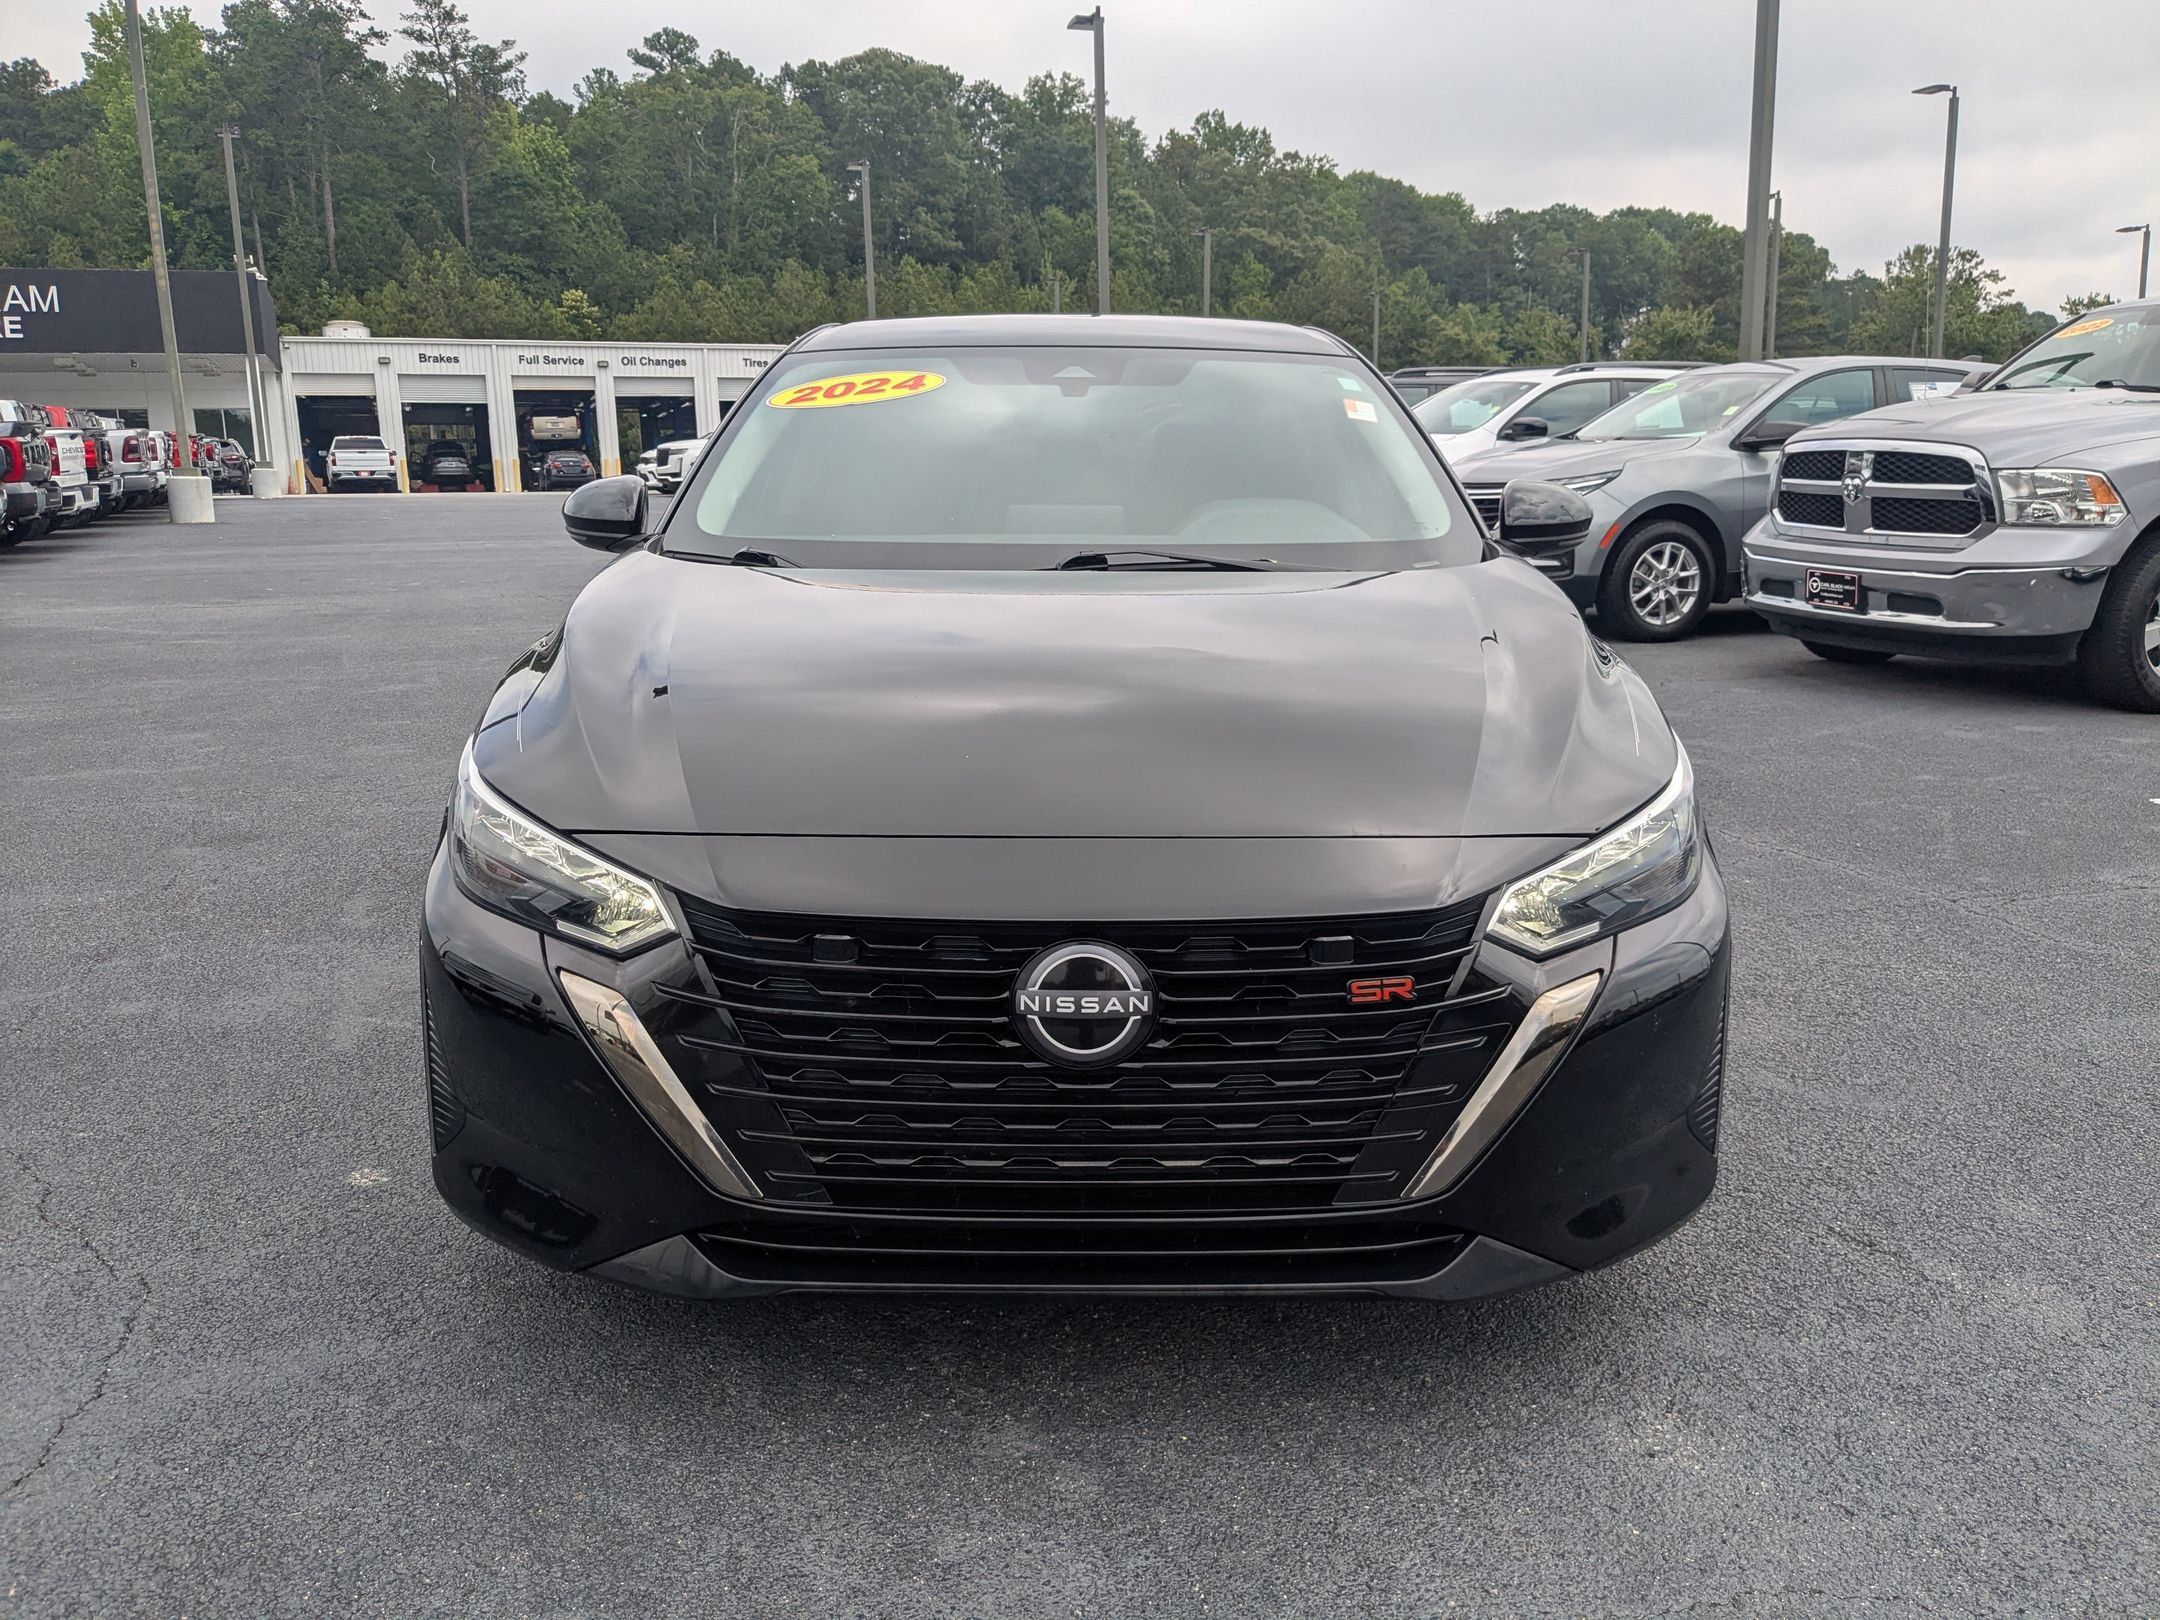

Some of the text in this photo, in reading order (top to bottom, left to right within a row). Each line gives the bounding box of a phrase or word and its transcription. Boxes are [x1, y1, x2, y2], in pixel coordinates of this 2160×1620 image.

[0, 285, 60, 312] AM
[418, 353, 460, 364] Brakes
[518, 355, 585, 366] Full Service
[620, 357, 687, 369] Oil Changes
[742, 358, 769, 368] Tires
[784, 374, 928, 405] 2024
[1349, 977, 1415, 1003] SR
[1019, 994, 1149, 1014] NISSAN
